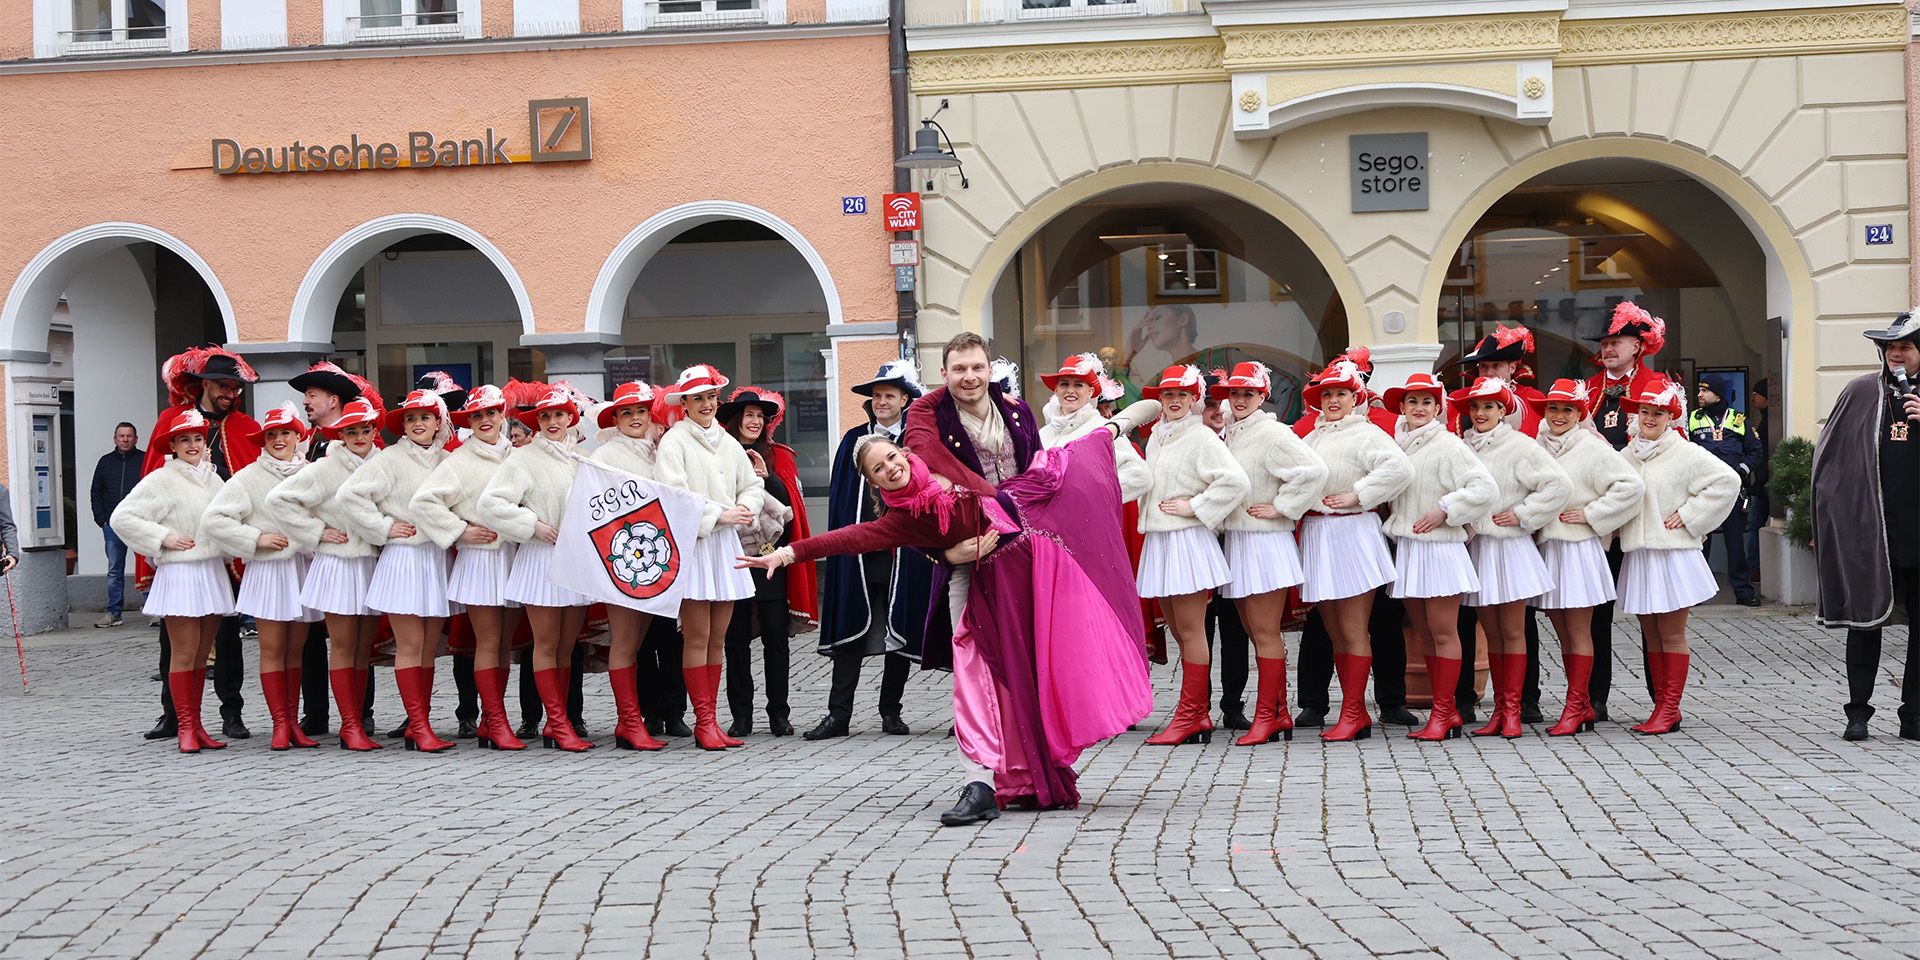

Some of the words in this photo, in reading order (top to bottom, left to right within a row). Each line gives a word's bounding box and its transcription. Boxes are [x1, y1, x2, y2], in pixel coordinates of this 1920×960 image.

[211, 134, 399, 175] Deutsche
[408, 128, 513, 168] Bank
[1358, 152, 1424, 175] Sego.
[1361, 175, 1421, 194] store
[845, 198, 864, 213] 26
[889, 218, 916, 228] WLAN
[898, 210, 917, 219] CITY
[1870, 226, 1889, 243] 24
